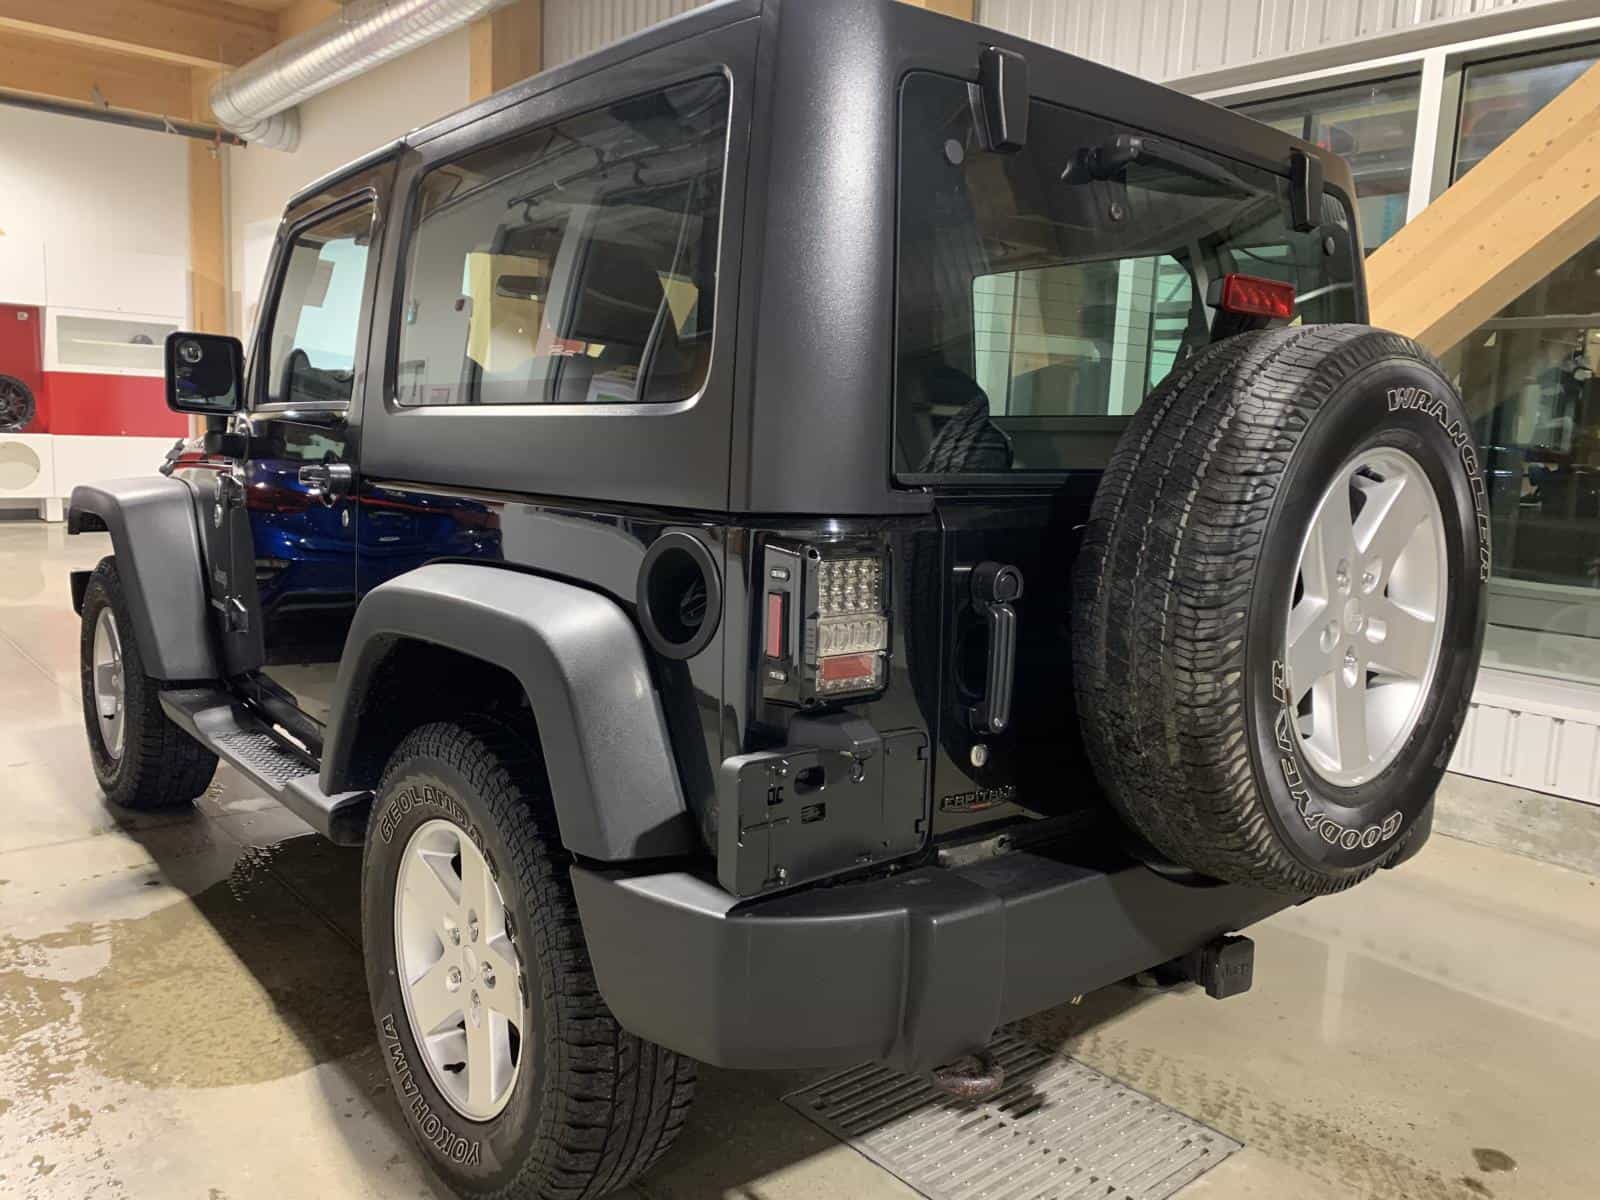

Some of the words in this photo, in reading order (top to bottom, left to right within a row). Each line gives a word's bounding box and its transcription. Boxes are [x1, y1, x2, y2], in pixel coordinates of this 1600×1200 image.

[1386, 386, 1490, 583] WRANGLER
[1272, 659, 1403, 850] GOODYEAR
[380, 1013, 480, 1166] YOKOHAMA
